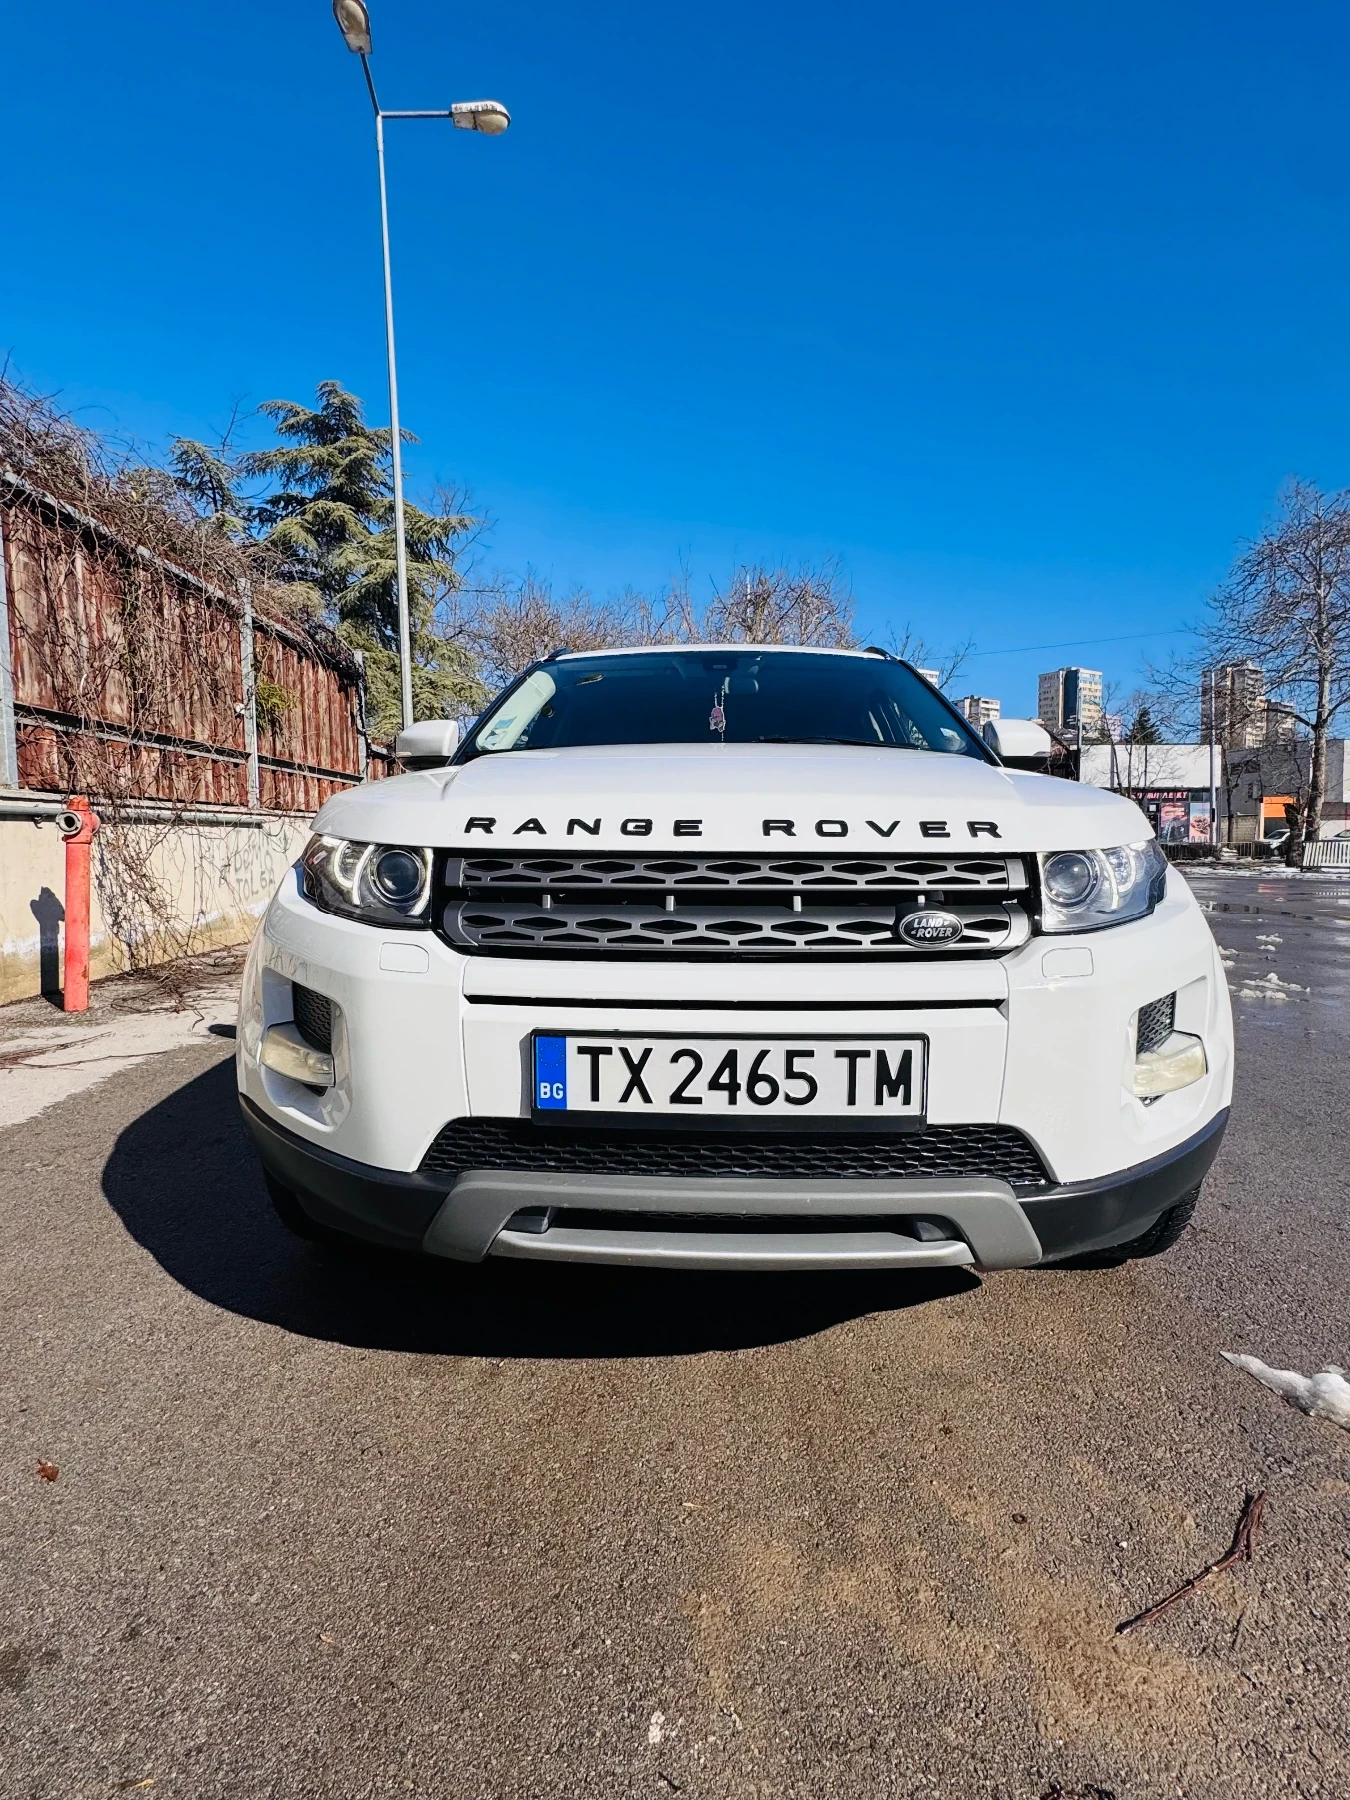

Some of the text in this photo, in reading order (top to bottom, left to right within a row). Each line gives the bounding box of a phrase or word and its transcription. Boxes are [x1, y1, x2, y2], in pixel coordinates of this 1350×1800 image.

[463, 816, 1004, 840] RANGE ROVER
[913, 917, 944, 928] LAND
[916, 927, 953, 938] ROVER
[576, 1045, 913, 1107] TX 2465 TM
[539, 1082, 564, 1100] BG
